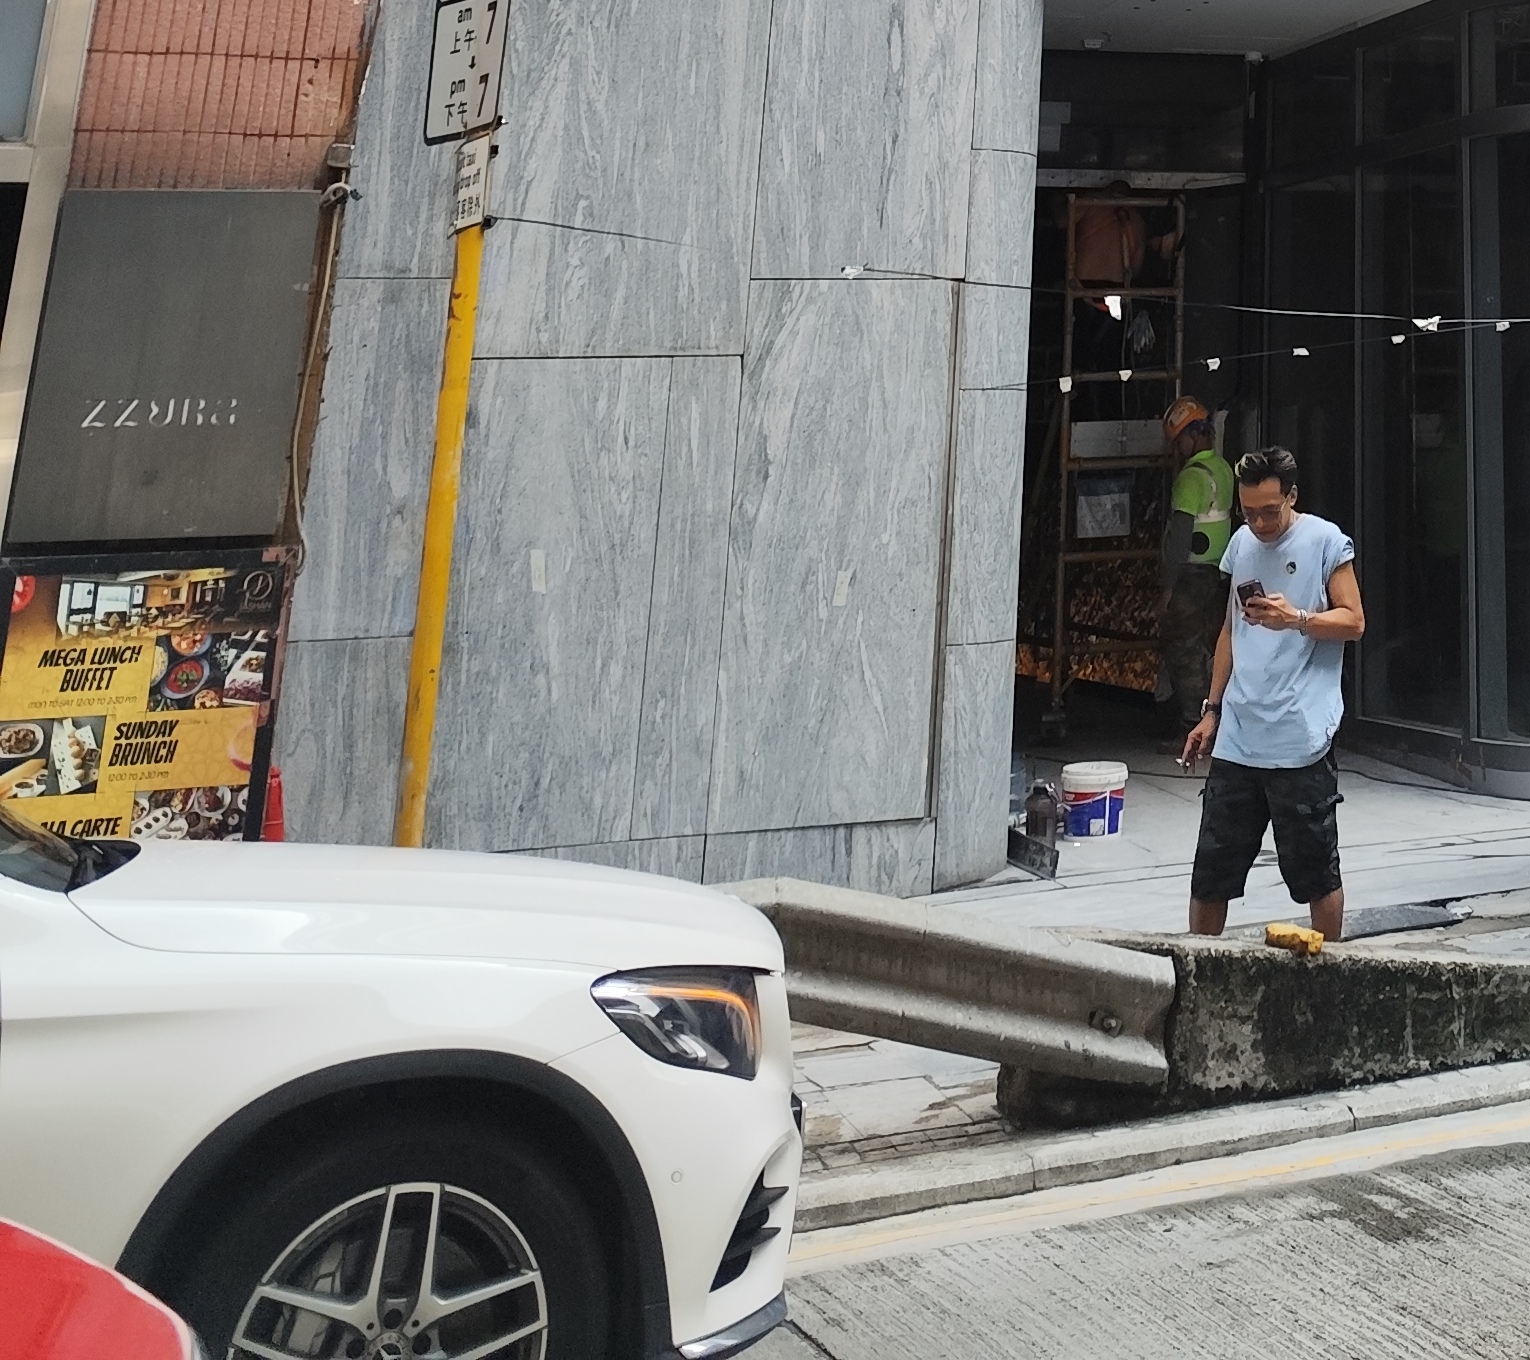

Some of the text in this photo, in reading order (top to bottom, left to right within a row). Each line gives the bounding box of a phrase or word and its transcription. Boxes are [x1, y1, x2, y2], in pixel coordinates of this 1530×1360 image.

[457, 0, 498, 45] am 7
[450, 28, 477, 55] 上午
[450, 73, 490, 118] pm 7
[444, 100, 468, 127] 下午
[37, 645, 143, 668] MEGA LUNCH
[59, 667, 117, 693] BUFFET
[114, 719, 179, 741] SUNDAY
[108, 739, 179, 767] BRUNCH
[70, 816, 122, 838] CARTE
